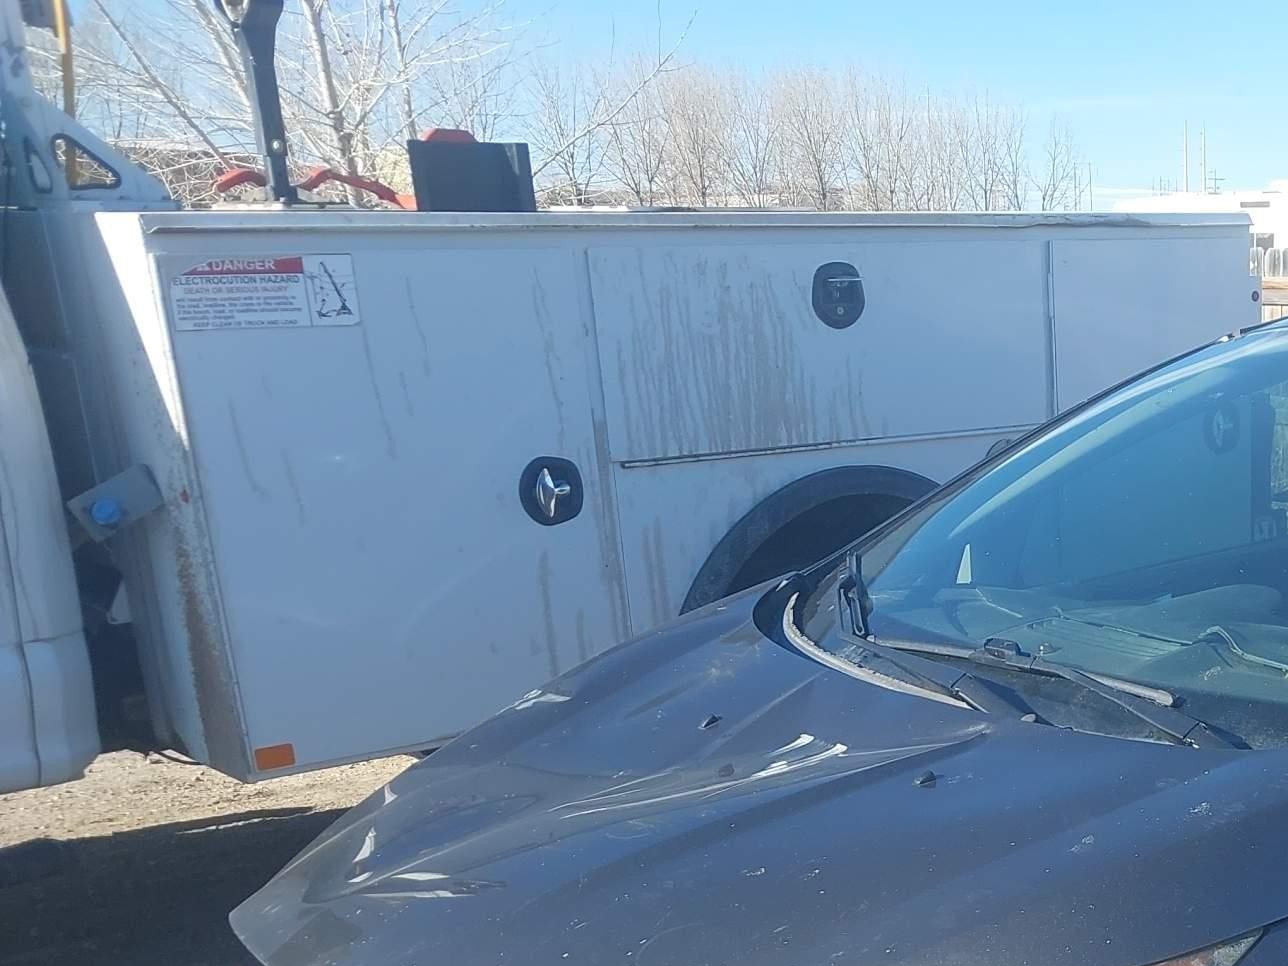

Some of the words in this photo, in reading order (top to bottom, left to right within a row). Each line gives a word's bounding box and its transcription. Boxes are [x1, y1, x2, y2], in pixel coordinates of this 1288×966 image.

[211, 259, 276, 271] DANGER
[173, 276, 257, 286] ELECTROCUTION
[260, 274, 300, 284] HAZARD
[184, 287, 210, 295] DEATH
[211, 286, 223, 294] OR
[225, 286, 260, 294] SERIOUS
[261, 285, 289, 293] INJURY
